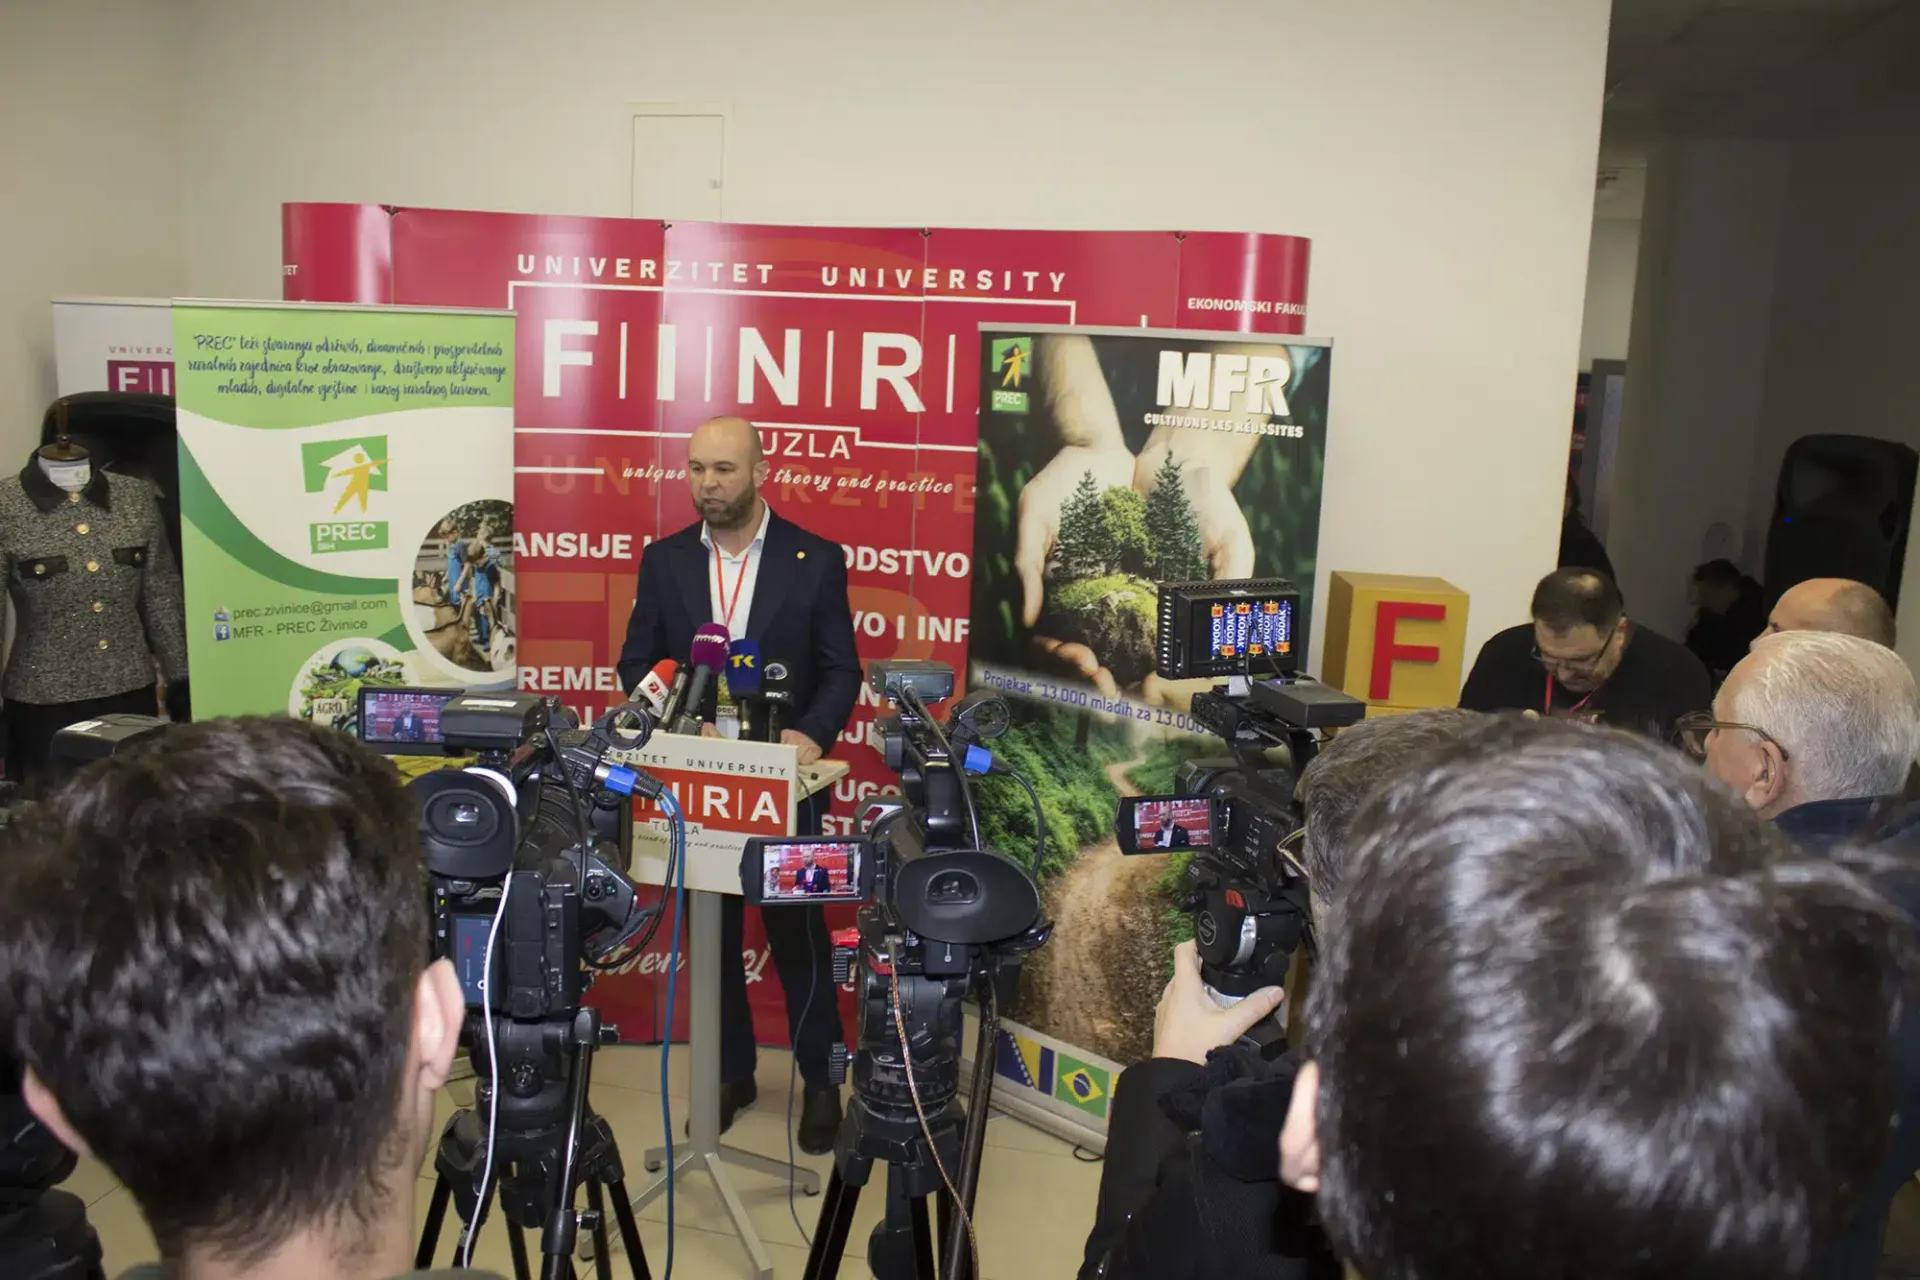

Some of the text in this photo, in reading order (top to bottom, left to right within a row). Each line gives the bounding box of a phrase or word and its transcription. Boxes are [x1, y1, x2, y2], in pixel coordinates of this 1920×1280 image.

[517, 254, 1065, 293] UNIVERZITET UNIVERSITY
[1187, 297, 1271, 313] EKONOMSKI
[109, 346, 172, 355] UNIVERZ
[239, 357, 292, 380] zajednica
[1156, 350, 1291, 416] MFR
[995, 391, 1022, 405] PREC
[1144, 413, 1304, 439] CULTIVONS LES RÉUSSITES
[623, 465, 687, 483] unique
[774, 468, 953, 494] theory and practice
[317, 523, 376, 541] PREC
[233, 599, 388, 620] prec.zivinice@gmail.com
[233, 625, 264, 639] MFR
[276, 620, 316, 635] PREC
[319, 617, 368, 632] Živinice
[1213, 618, 1221, 650] KODAK
[1227, 612, 1235, 645] KODAK
[1237, 616, 1246, 648] KODAK
[1263, 615, 1271, 647] KODAK
[1278, 609, 1287, 641] KODAK
[1369, 601, 1446, 700] F
[314, 701, 344, 715] AGRO
[983, 670, 1032, 695] Projekat
[1090, 697, 1133, 718] mladih
[1136, 707, 1152, 722] za
[686, 758, 787, 776] UNIVERSITY
[652, 820, 700, 835] TULA
